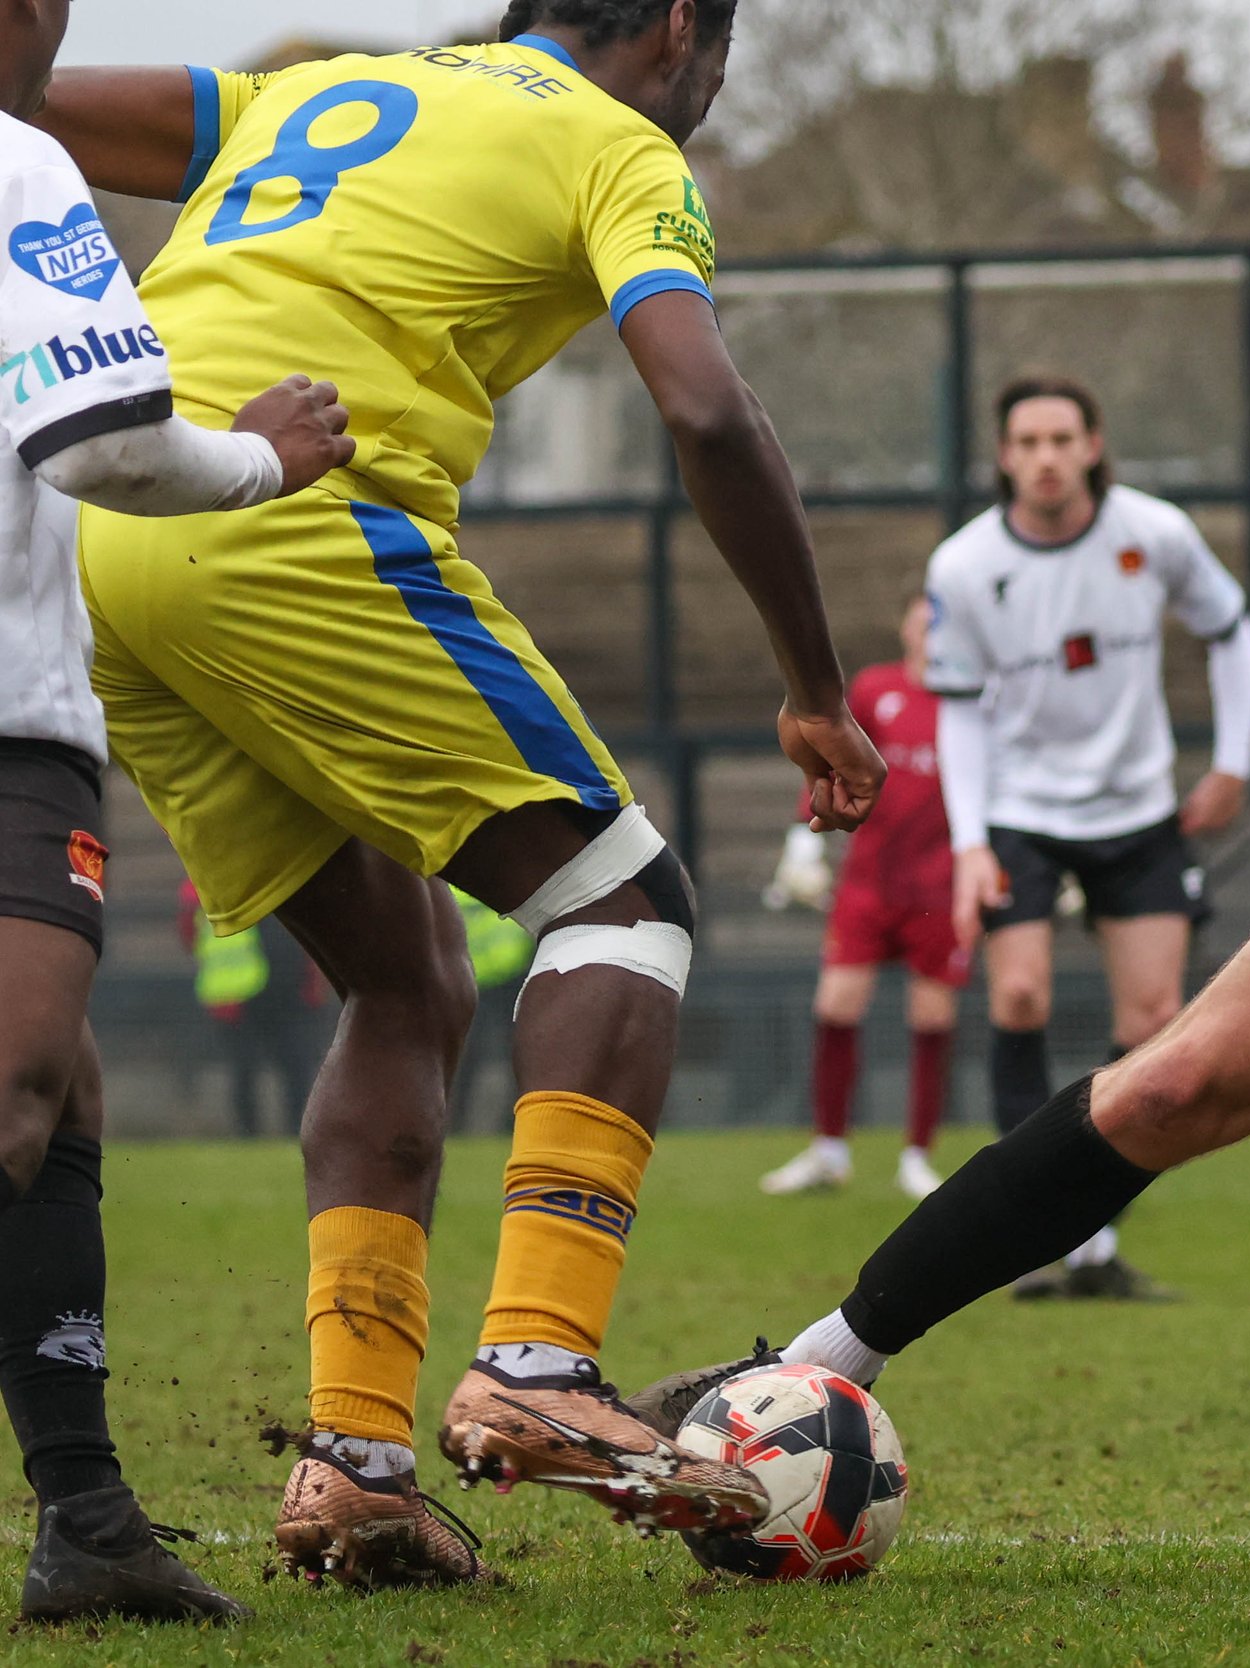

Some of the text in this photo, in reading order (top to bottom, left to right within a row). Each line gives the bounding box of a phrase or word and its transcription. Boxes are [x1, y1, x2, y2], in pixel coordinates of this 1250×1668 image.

[204, 80, 418, 246] 8
[17, 239, 45, 253] THANK
[63, 228, 77, 241] ST
[46, 235, 107, 278] NHS
[70, 268, 104, 290] HEROES
